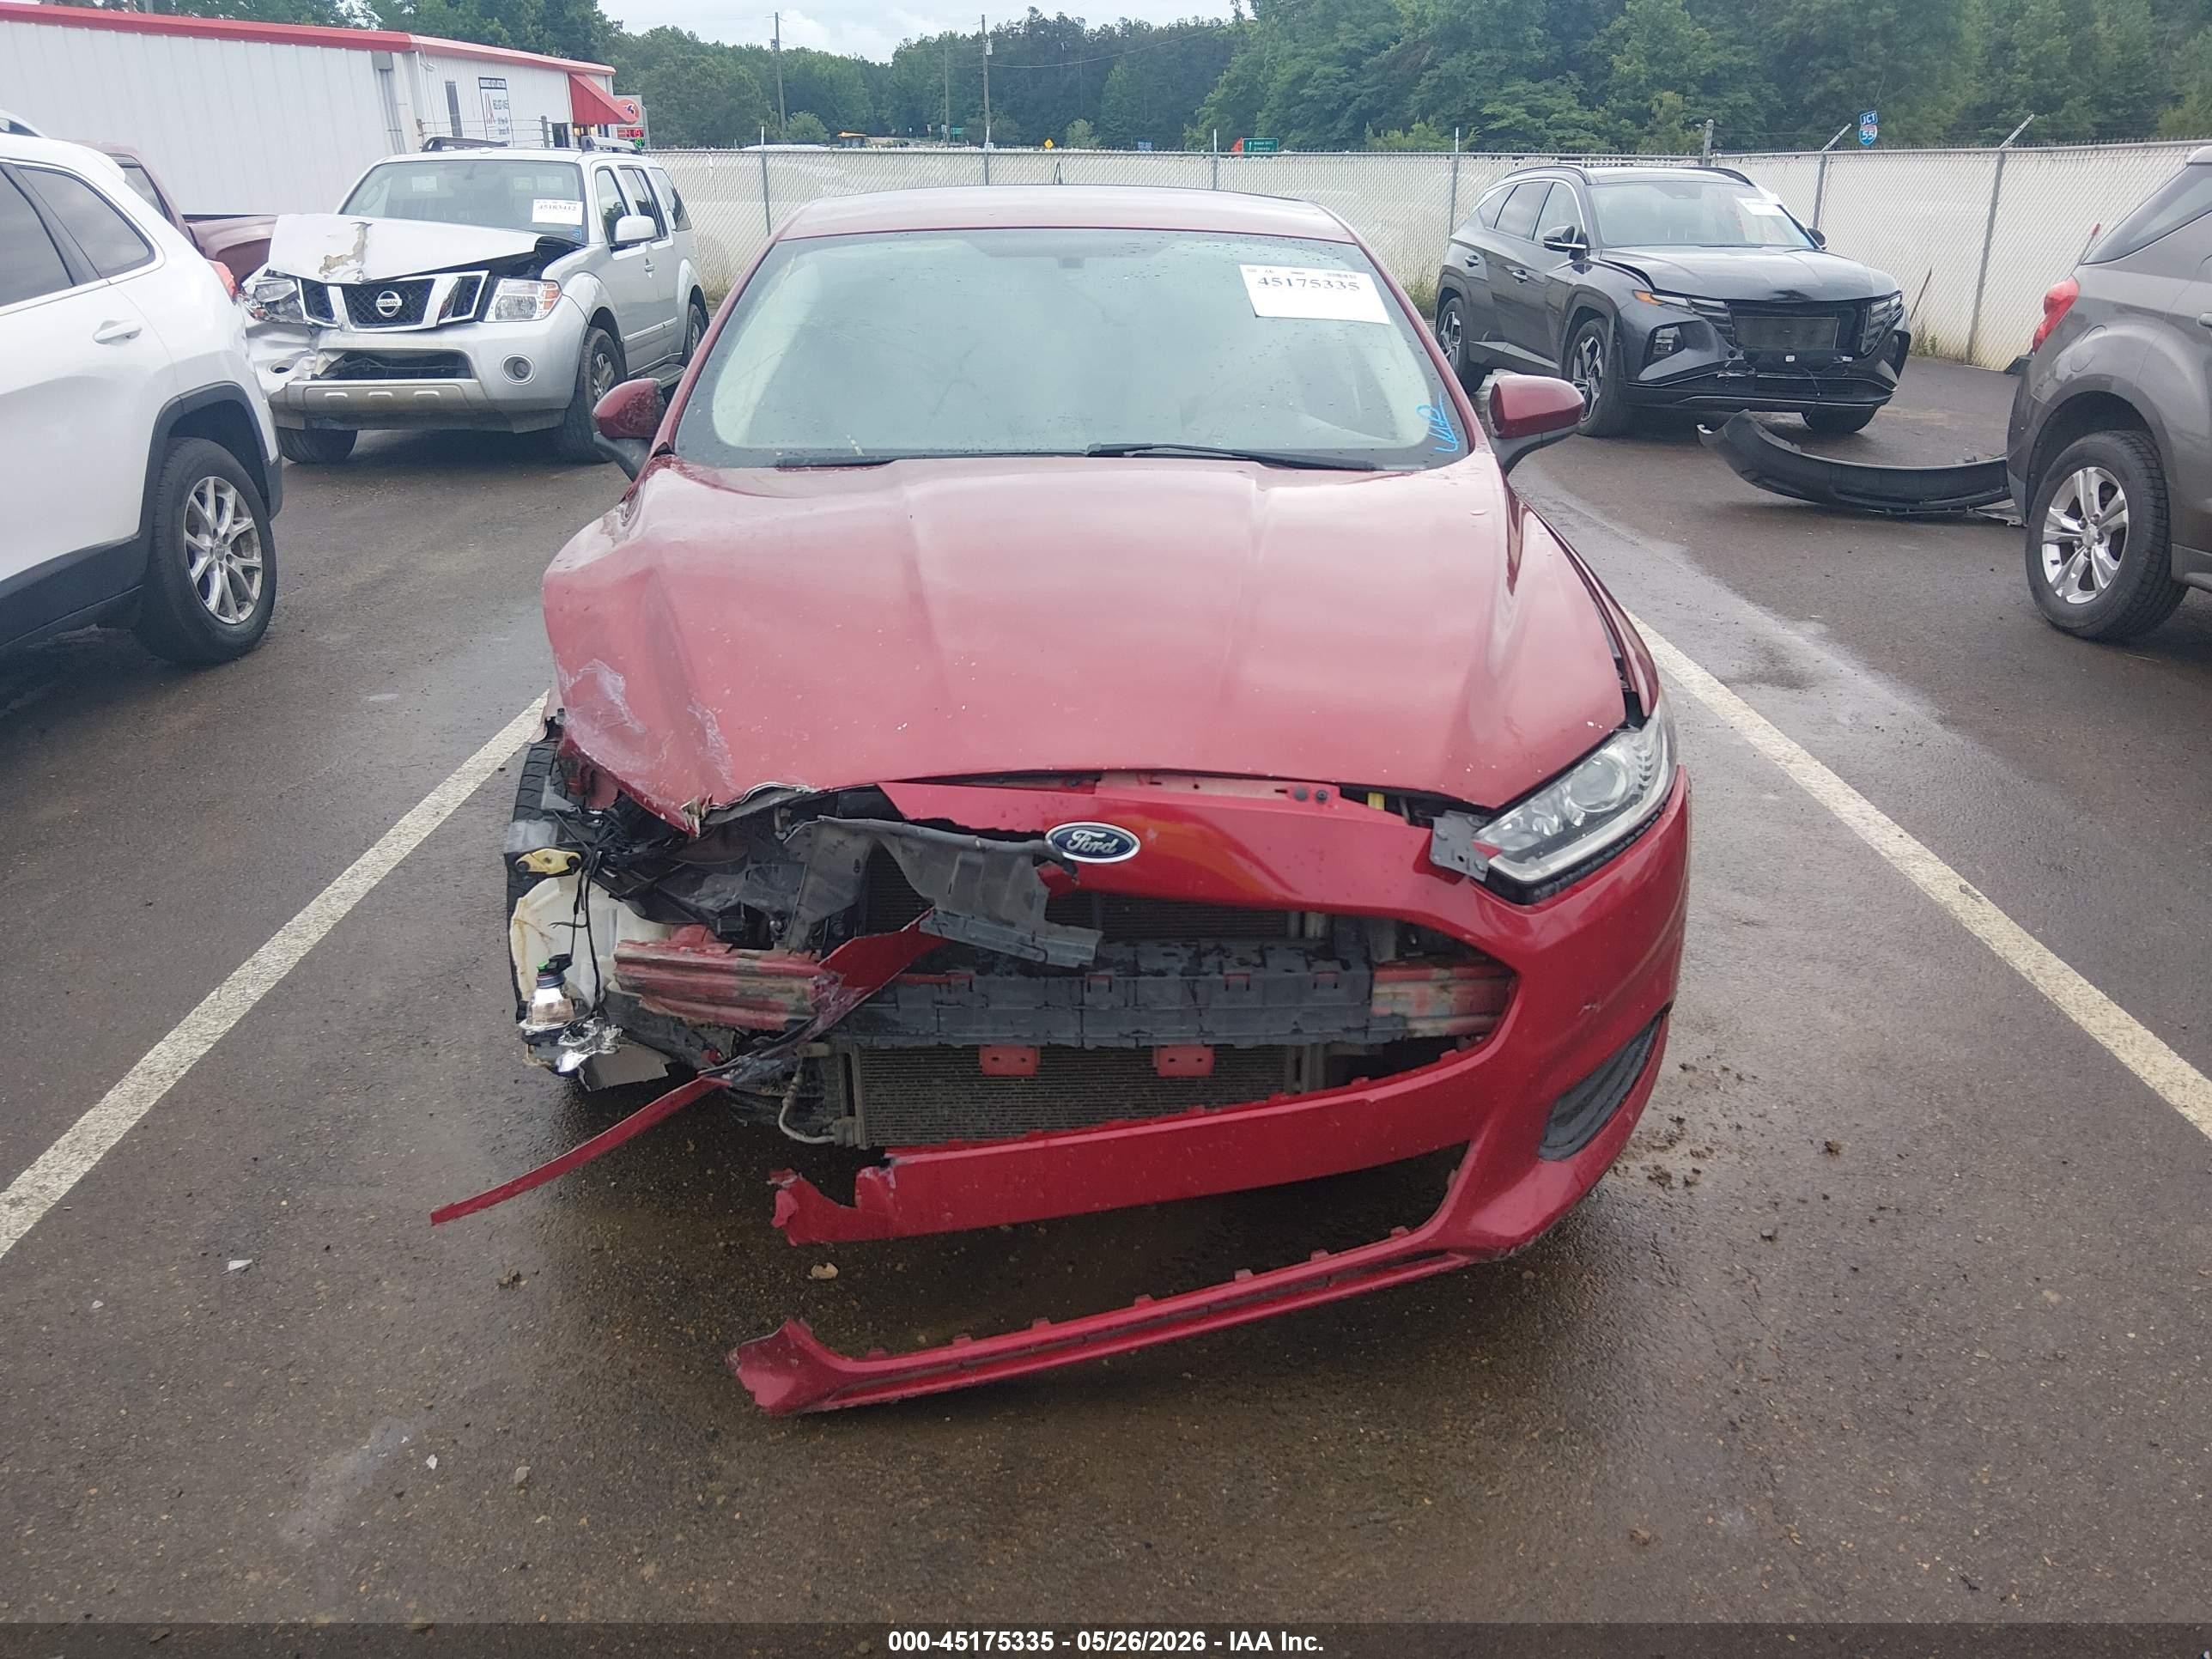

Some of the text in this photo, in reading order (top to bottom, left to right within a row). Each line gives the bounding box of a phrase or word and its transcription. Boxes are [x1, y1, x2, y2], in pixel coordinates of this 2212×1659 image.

[1862, 112, 1875, 125] JCT
[1862, 131, 1875, 140] 55
[1257, 276, 1360, 291] 45175335
[1066, 830, 1119, 854] Ford
